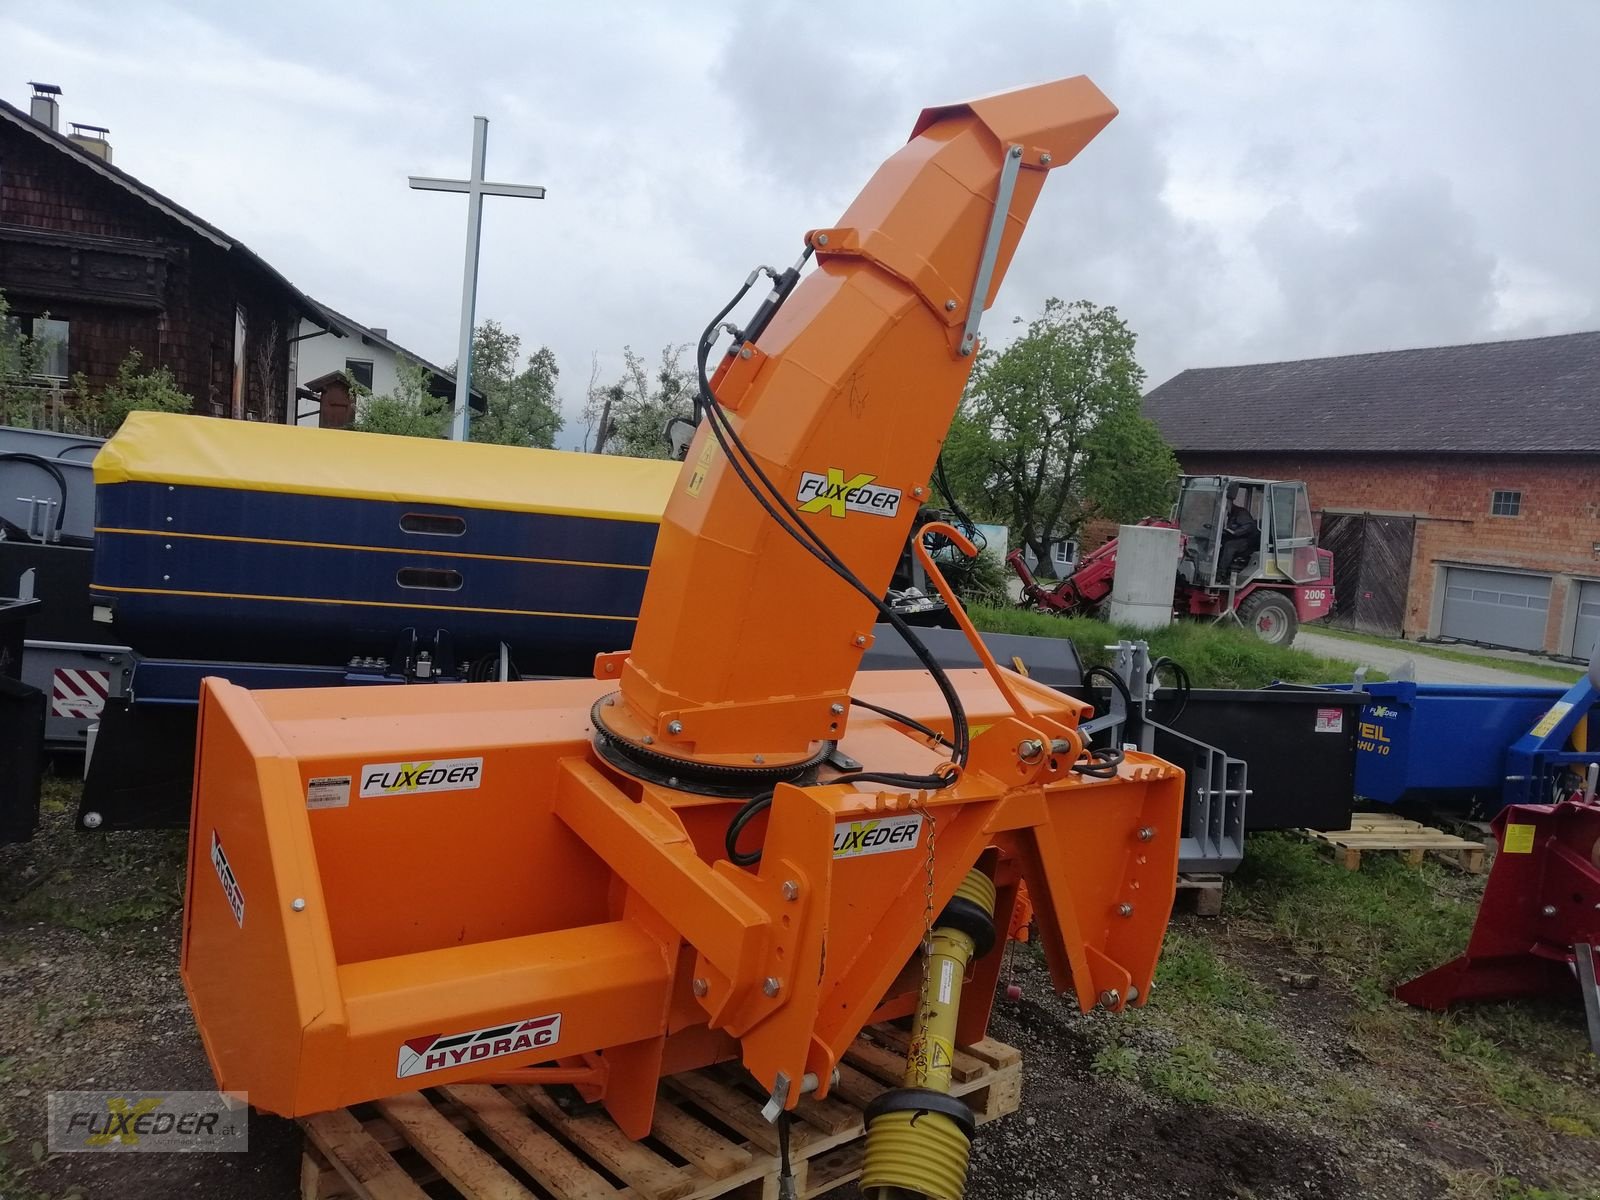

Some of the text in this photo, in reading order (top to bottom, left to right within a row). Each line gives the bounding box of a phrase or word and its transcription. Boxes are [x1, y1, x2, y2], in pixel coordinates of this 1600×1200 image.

[800, 478, 900, 510] FLIXEDER
[1304, 590, 1326, 600] 2006
[1359, 722, 1391, 742] EIL
[1378, 745, 1390, 755] 10
[363, 766, 479, 790] FLIXEDER
[833, 824, 918, 851] LIXEDER
[425, 1029, 553, 1070] HYDRAC
